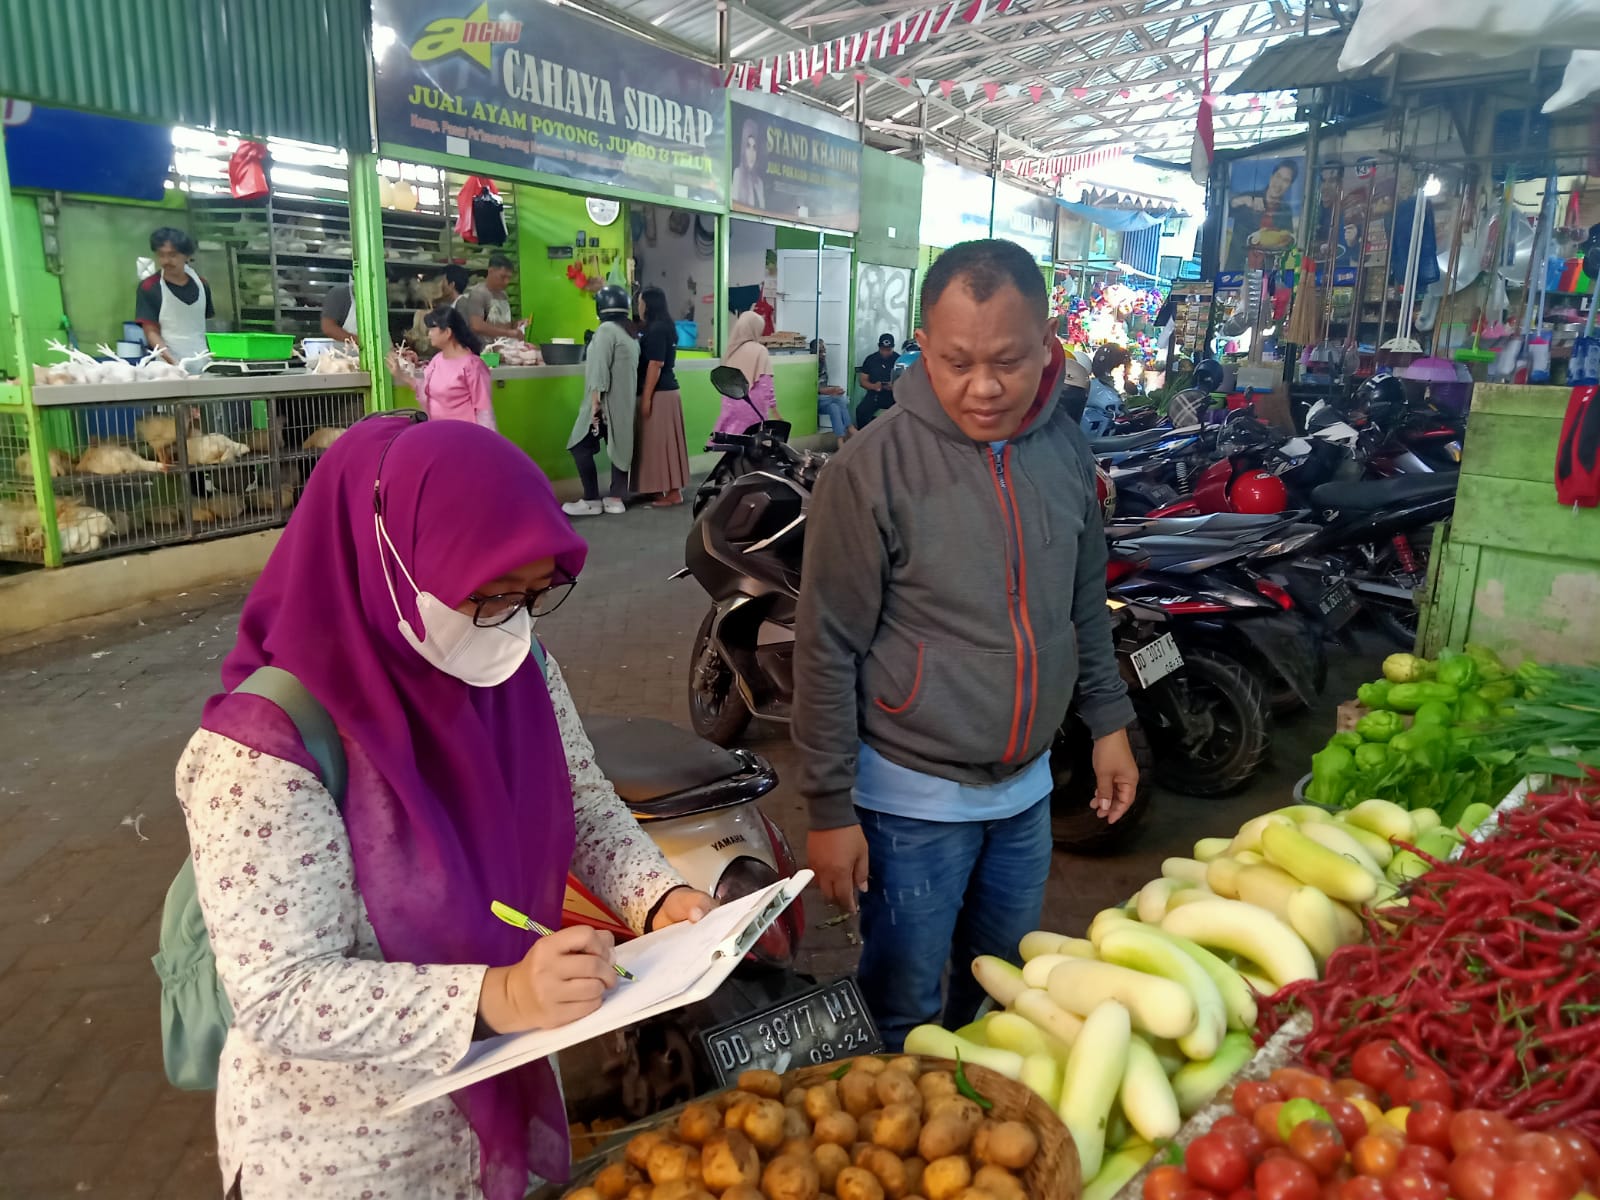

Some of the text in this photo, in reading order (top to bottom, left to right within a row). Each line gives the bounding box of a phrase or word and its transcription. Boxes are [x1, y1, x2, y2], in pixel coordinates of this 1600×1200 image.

[408, 84, 468, 117] JUAL
[471, 100, 528, 131] AYAM
[531, 114, 604, 152] POTONG,
[606, 135, 656, 161] JUMBO
[658, 147, 669, 163] &
[502, 47, 714, 149] CAHAYA SIDRAP
[766, 125, 809, 162] STAND
[716, 1034, 752, 1070] DD
[757, 1004, 817, 1054] 3877
